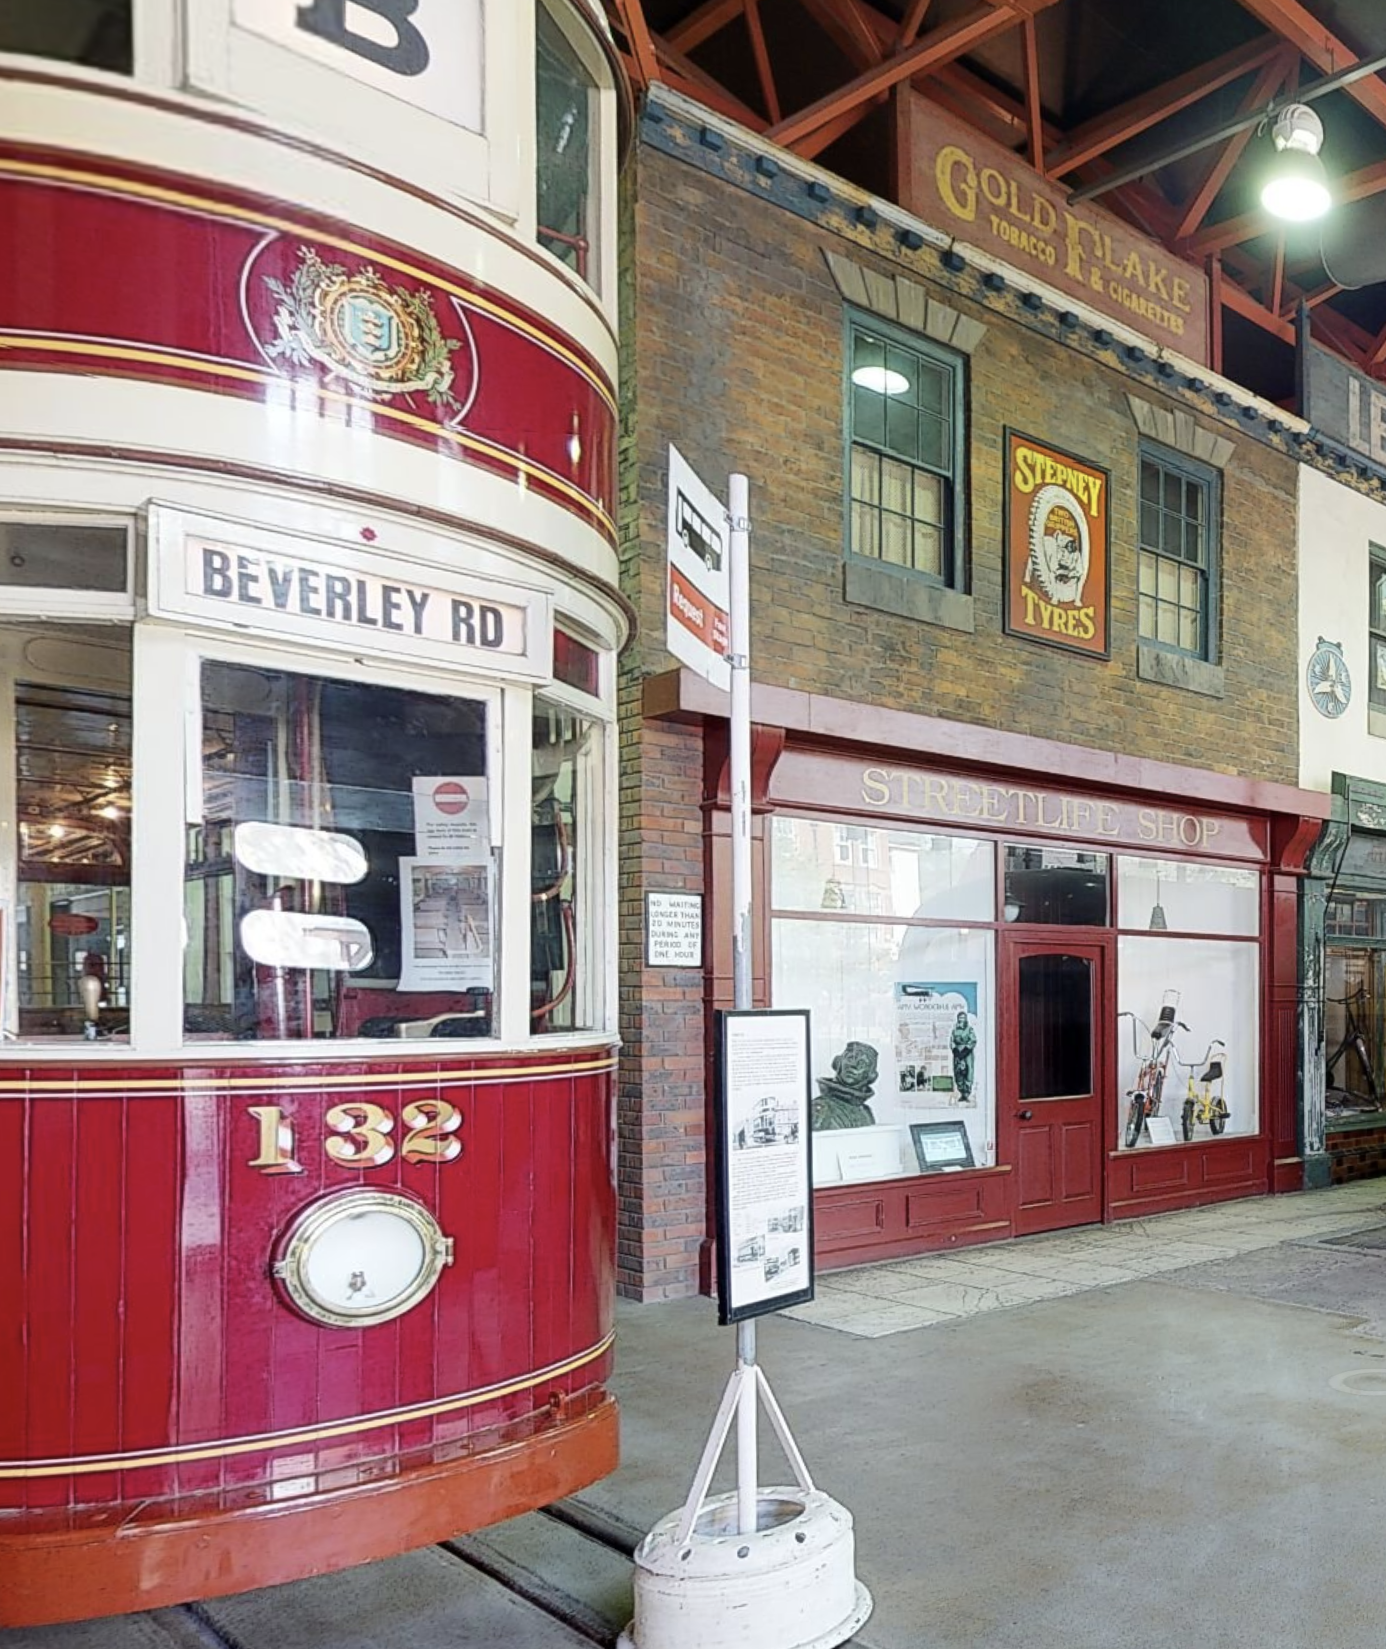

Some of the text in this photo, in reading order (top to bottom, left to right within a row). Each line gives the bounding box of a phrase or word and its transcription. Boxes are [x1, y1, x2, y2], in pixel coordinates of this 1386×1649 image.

[295, 0, 430, 77] B
[935, 145, 1191, 313] GOLD FLAKE
[989, 214, 1185, 337] TOBACCO & CIGARETTES
[1014, 445, 1102, 518] STEPNEY
[202, 547, 504, 648] BEVERLEY RD
[673, 582, 704, 629] Request
[1021, 585, 1096, 640] TYRES
[861, 767, 1220, 848] STREETLIFE SHOP
[651, 930, 700, 939] DURING ANY
[667, 920, 700, 929] MINUTES
[669, 901, 700, 909] WAITING
[654, 950, 669, 958] ONE
[688, 941, 698, 949] OF
[247, 1099, 464, 1175] 132
